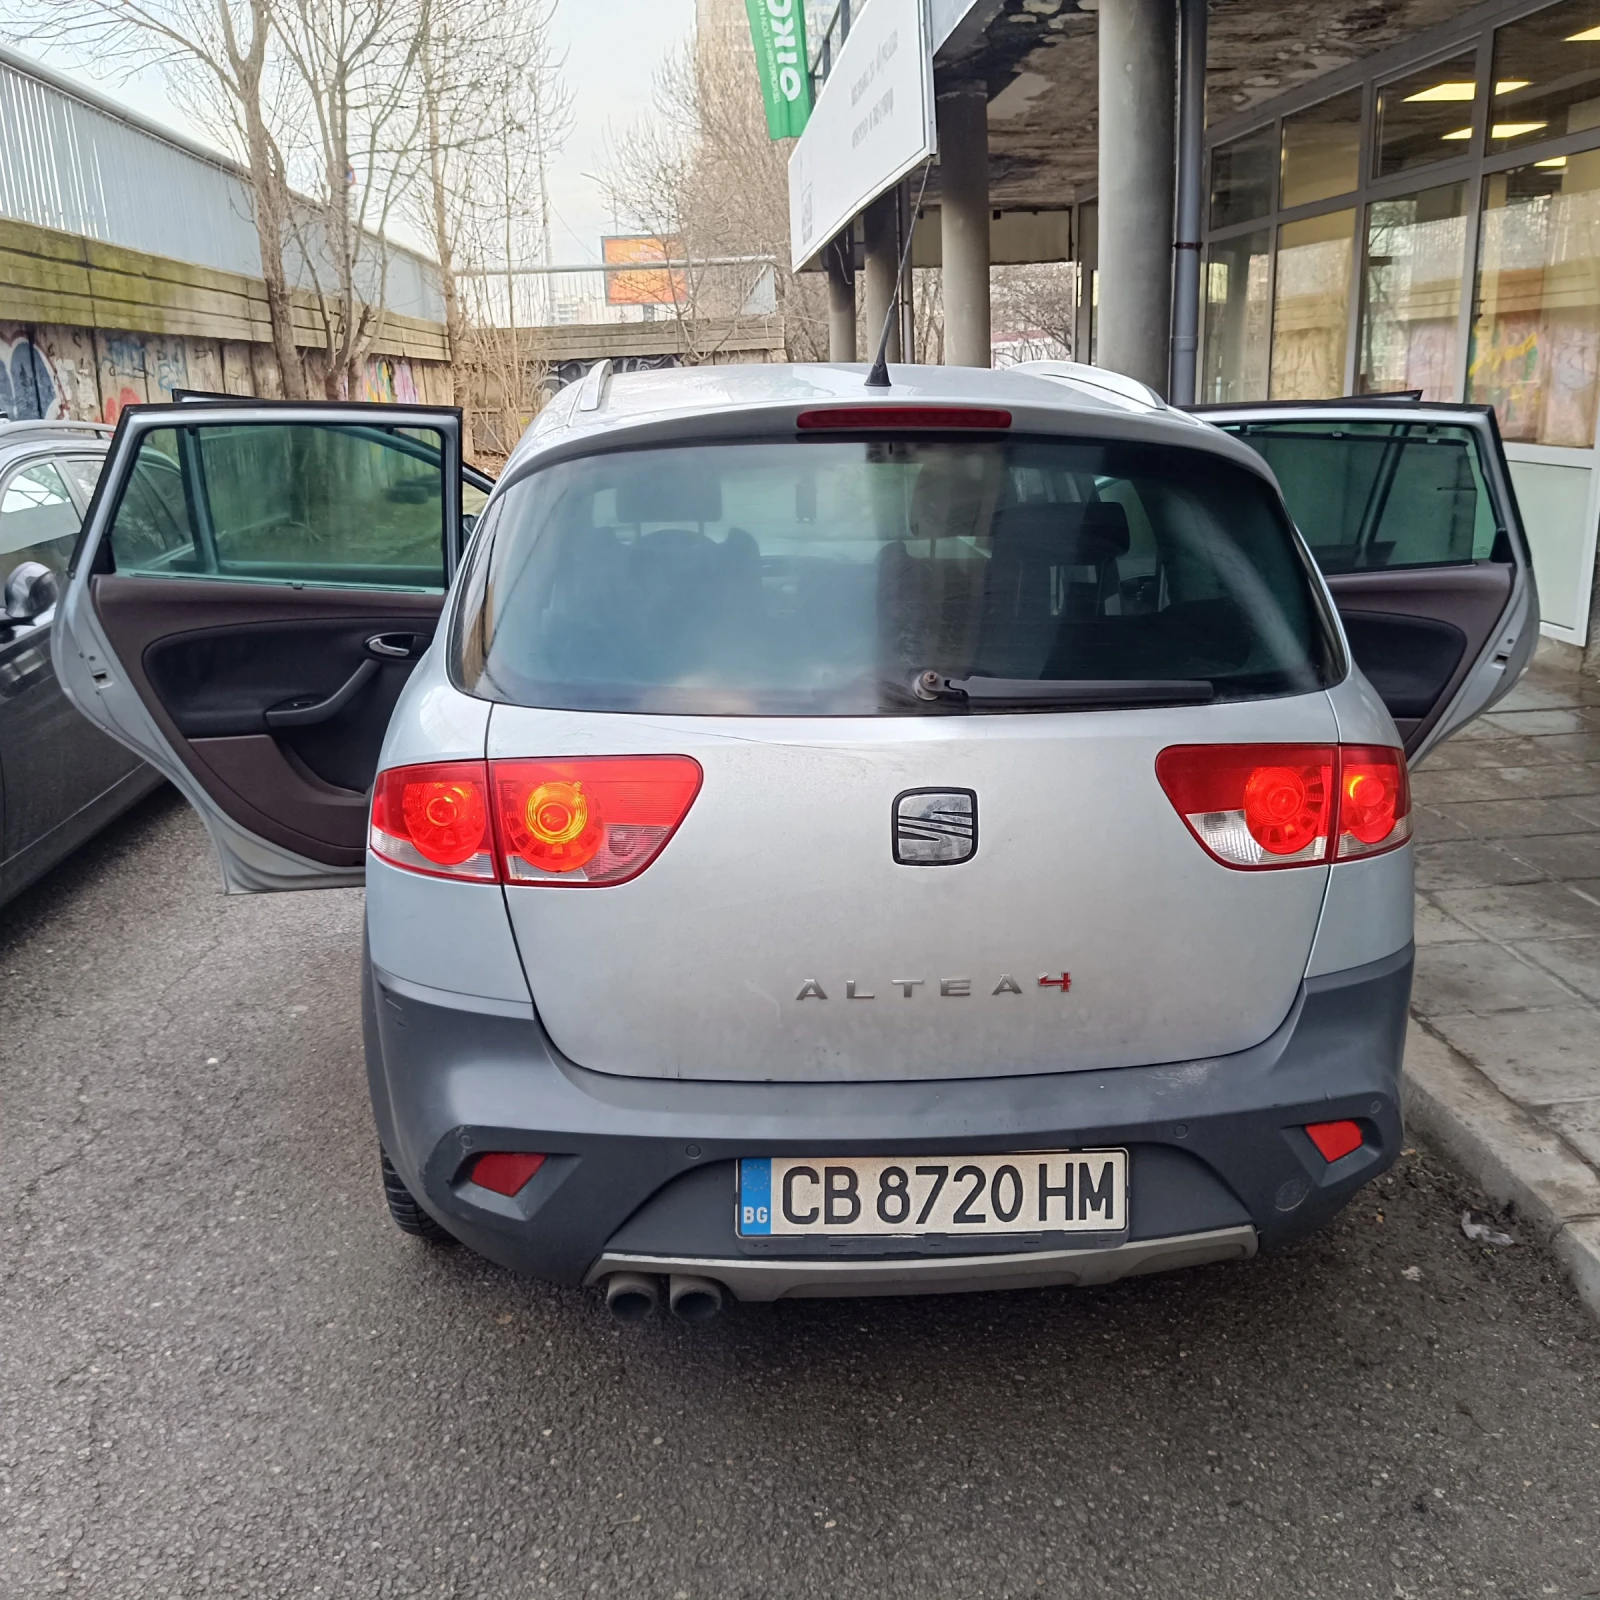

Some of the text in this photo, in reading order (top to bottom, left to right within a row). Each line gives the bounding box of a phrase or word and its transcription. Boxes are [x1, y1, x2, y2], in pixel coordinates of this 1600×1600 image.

[781, 1161, 1114, 1225] CB 8720 HM
[743, 1206, 768, 1225] BG
